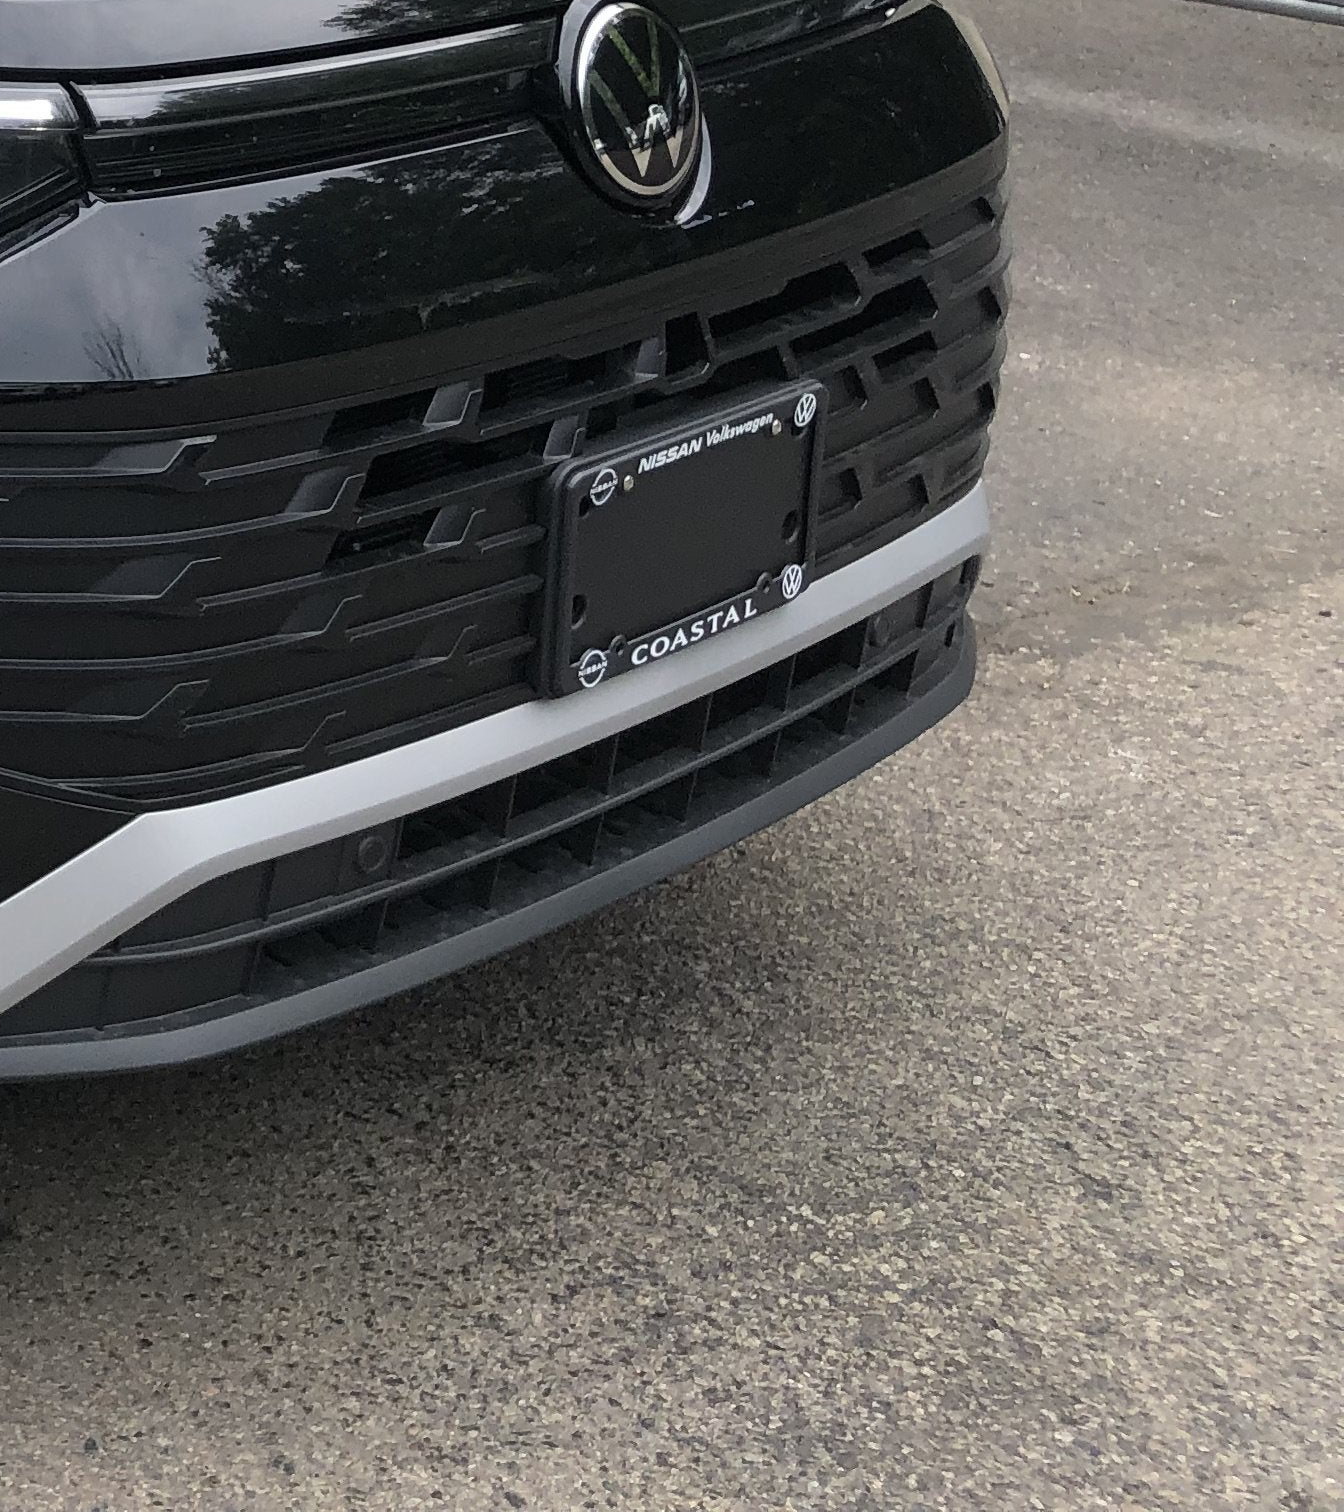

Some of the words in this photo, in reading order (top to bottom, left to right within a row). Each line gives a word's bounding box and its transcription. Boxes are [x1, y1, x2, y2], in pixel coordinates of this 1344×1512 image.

[637, 436, 703, 475] NISSAN
[706, 413, 774, 448] Volkswagen
[630, 597, 758, 665] COASTAL
